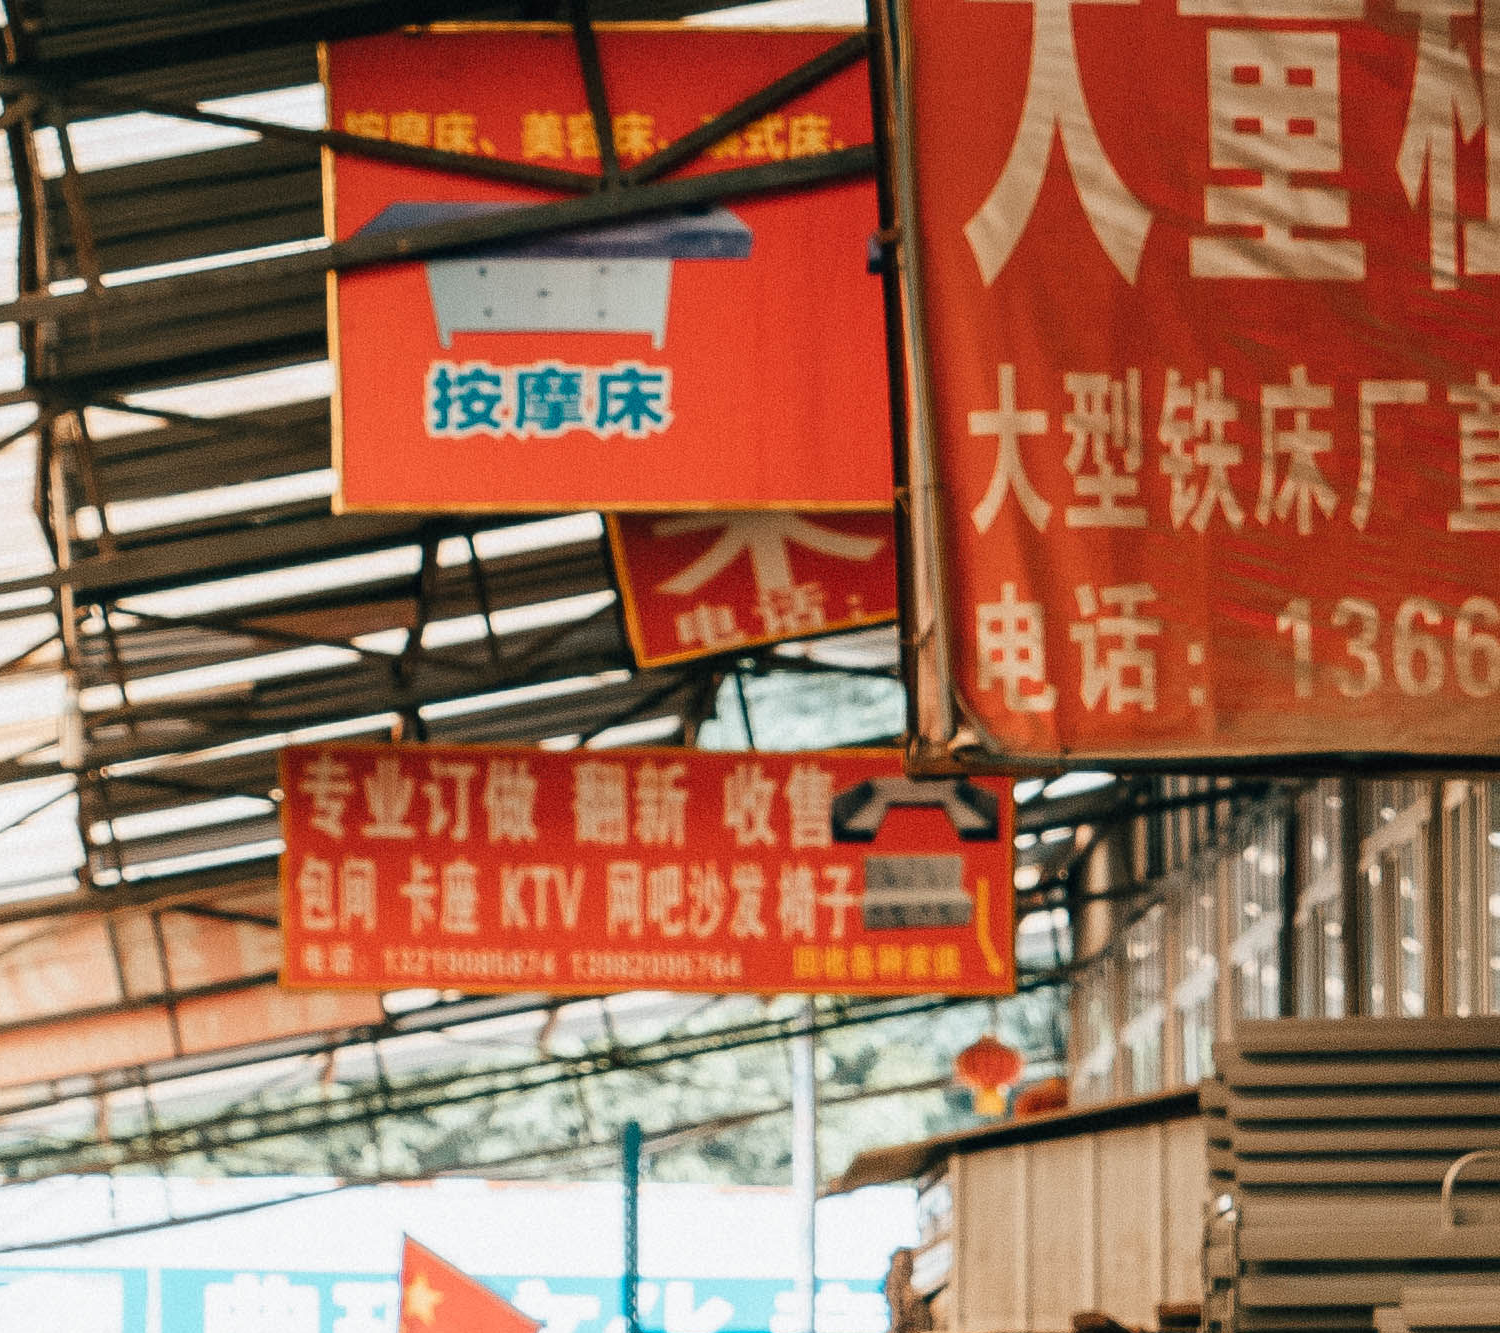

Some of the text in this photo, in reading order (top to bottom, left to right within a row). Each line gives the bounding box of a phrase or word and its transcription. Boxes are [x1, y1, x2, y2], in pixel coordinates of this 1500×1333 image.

[428, 362, 672, 437] 按摩床
[303, 757, 835, 850] 专业订做 翻新 收售
[400, 860, 480, 936] 卡座
[500, 863, 584, 931] KTV
